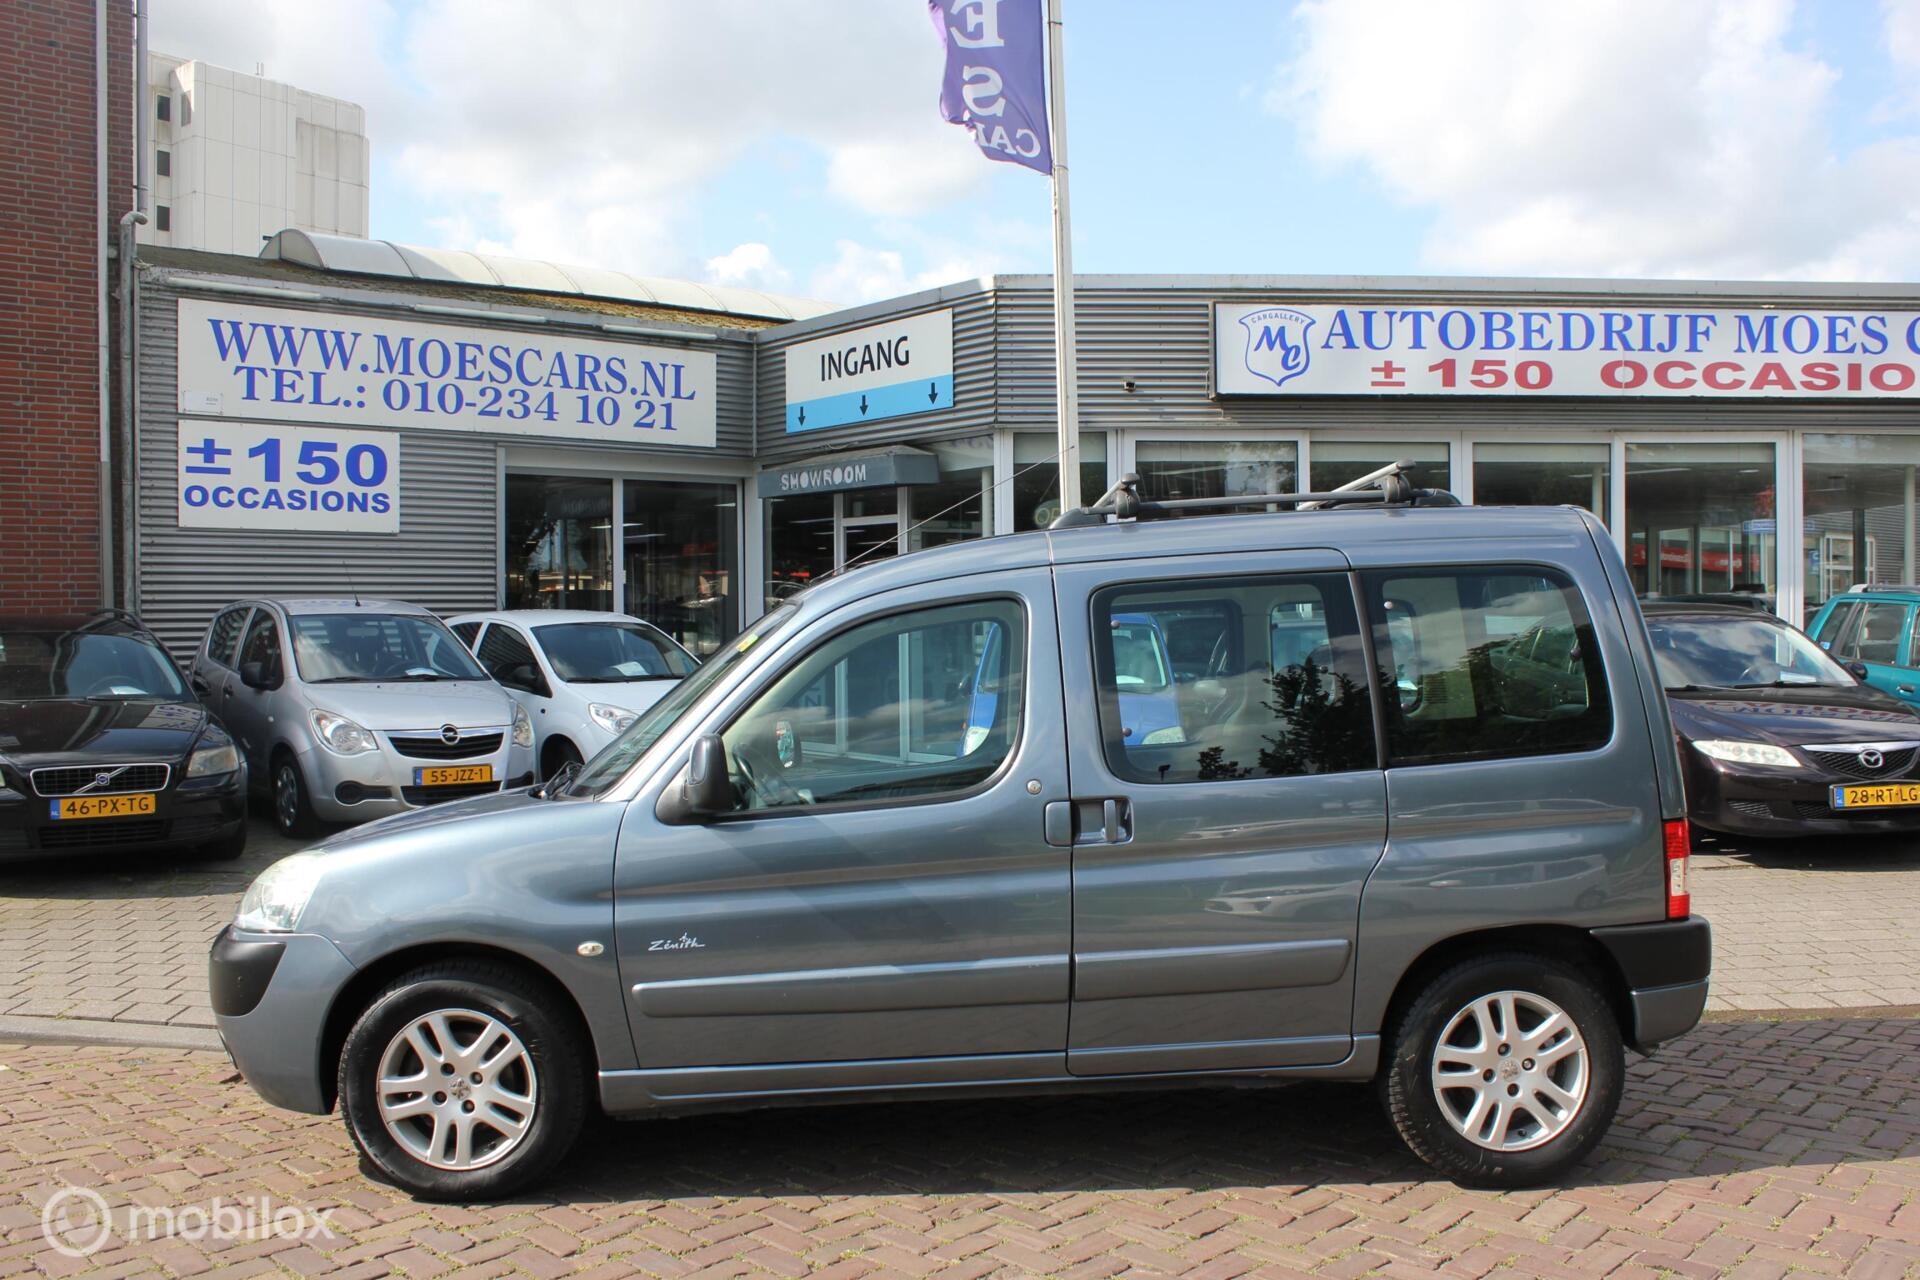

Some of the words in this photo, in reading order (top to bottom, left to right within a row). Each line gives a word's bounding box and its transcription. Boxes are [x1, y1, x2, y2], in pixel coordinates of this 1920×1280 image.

[1322, 309, 1717, 353] AUTOBEDRIJF
[1735, 313, 1890, 355] MOES
[209, 318, 697, 401] WWW.MOESCARS.NL
[821, 336, 910, 381] INGANG
[1429, 358, 1553, 390] 150
[1600, 359, 1916, 392] OCCASIO
[233, 365, 366, 409] TEL.:
[382, 378, 560, 422] 010-234
[576, 394, 621, 427] 10
[633, 399, 680, 431] 21
[780, 464, 866, 491] SHOWROOM
[184, 484, 391, 514] OCCASIONS
[430, 768, 484, 783] 55-JZZ-1
[66, 797, 149, 815] 46-PX-TG
[1849, 787, 1918, 804] 28-RT-LG
